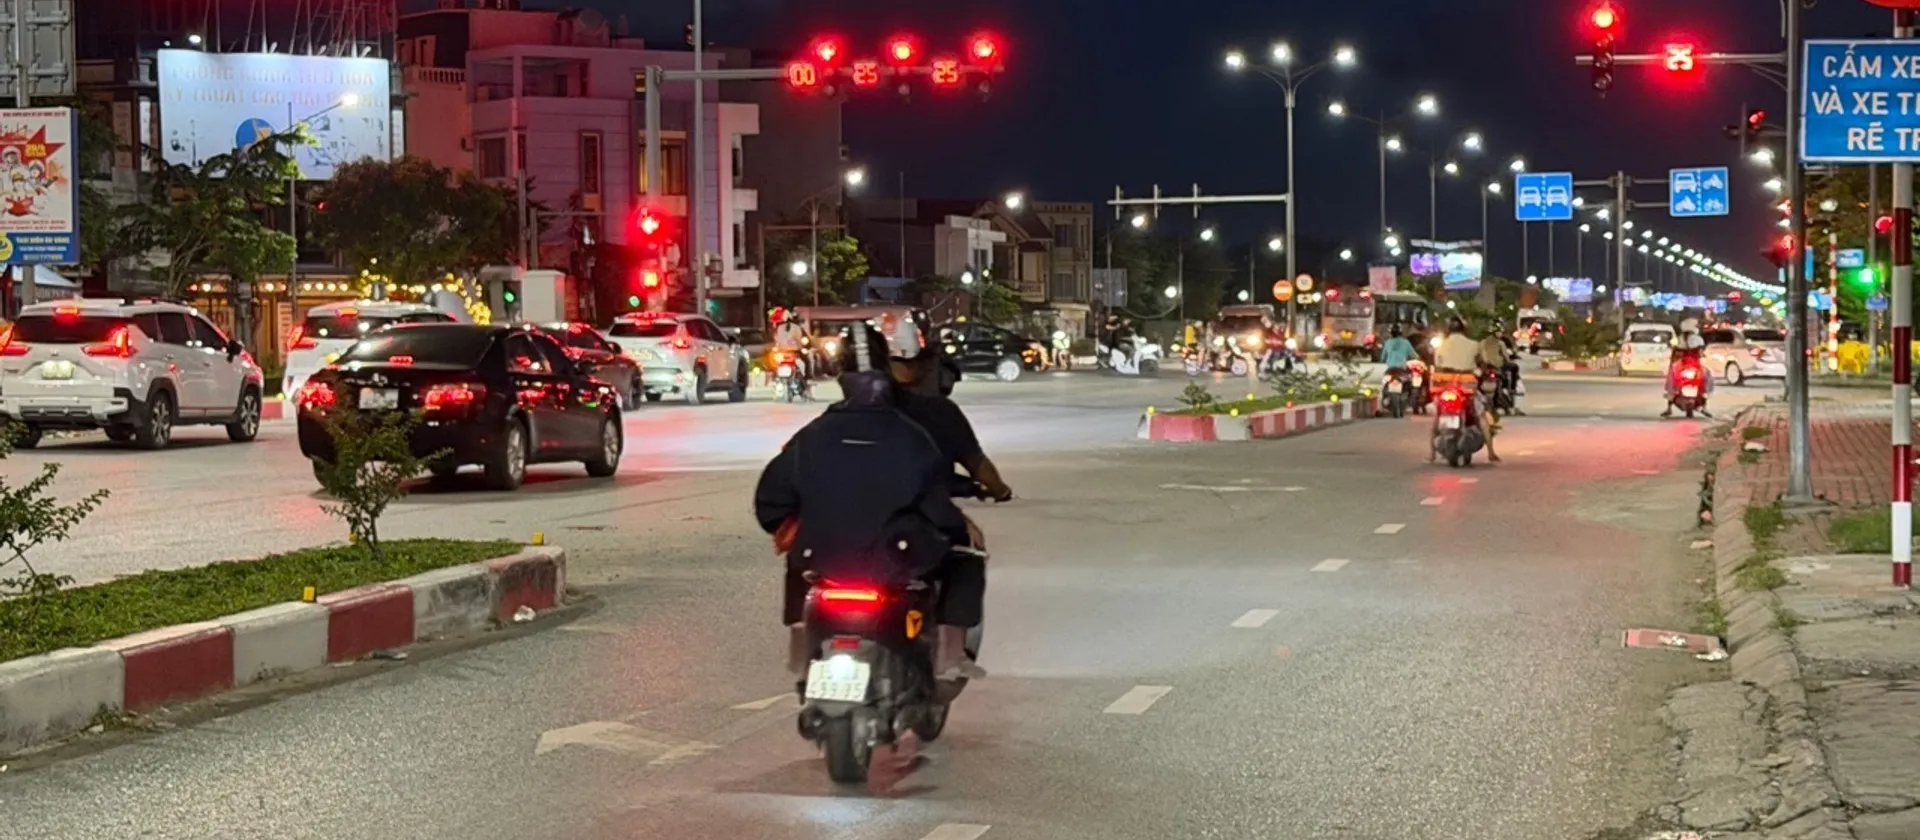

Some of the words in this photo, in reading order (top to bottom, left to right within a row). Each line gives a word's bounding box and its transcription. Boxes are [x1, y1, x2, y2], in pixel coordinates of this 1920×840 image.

[1665, 43, 1694, 71] 25
[1822, 43, 1882, 79] CẤM
[789, 63, 815, 86] 00
[853, 62, 878, 85] 25
[933, 60, 958, 84] 25
[1811, 85, 1845, 115] VÀ
[1852, 91, 1890, 116] XE
[1896, 92, 1920, 116] T
